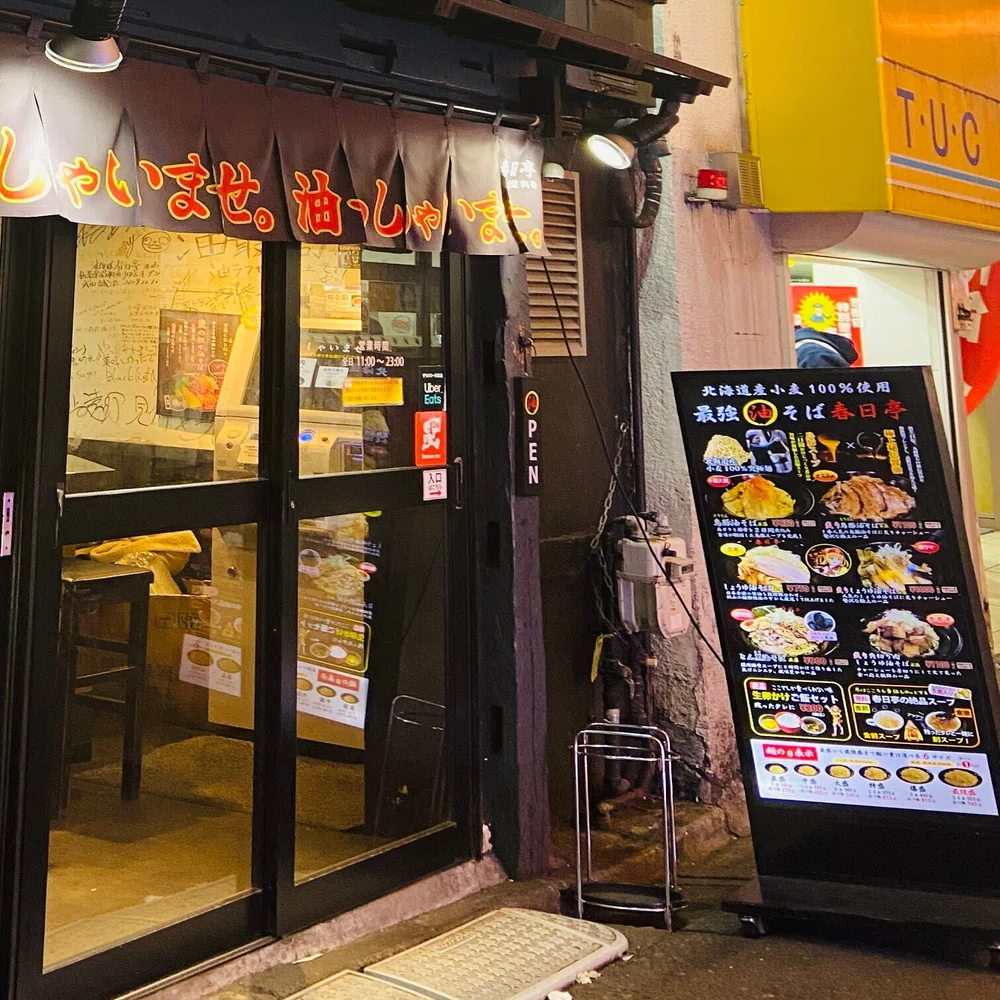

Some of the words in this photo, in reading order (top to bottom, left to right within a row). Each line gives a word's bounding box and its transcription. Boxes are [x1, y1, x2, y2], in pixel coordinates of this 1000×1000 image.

[424, 382, 442, 393] Uber
[702, 381, 890, 396] 北海道産小麦100%使用
[424, 394, 441, 405] Eats
[831, 400, 907, 421] 春日亭
[428, 473, 442, 483] 入口
